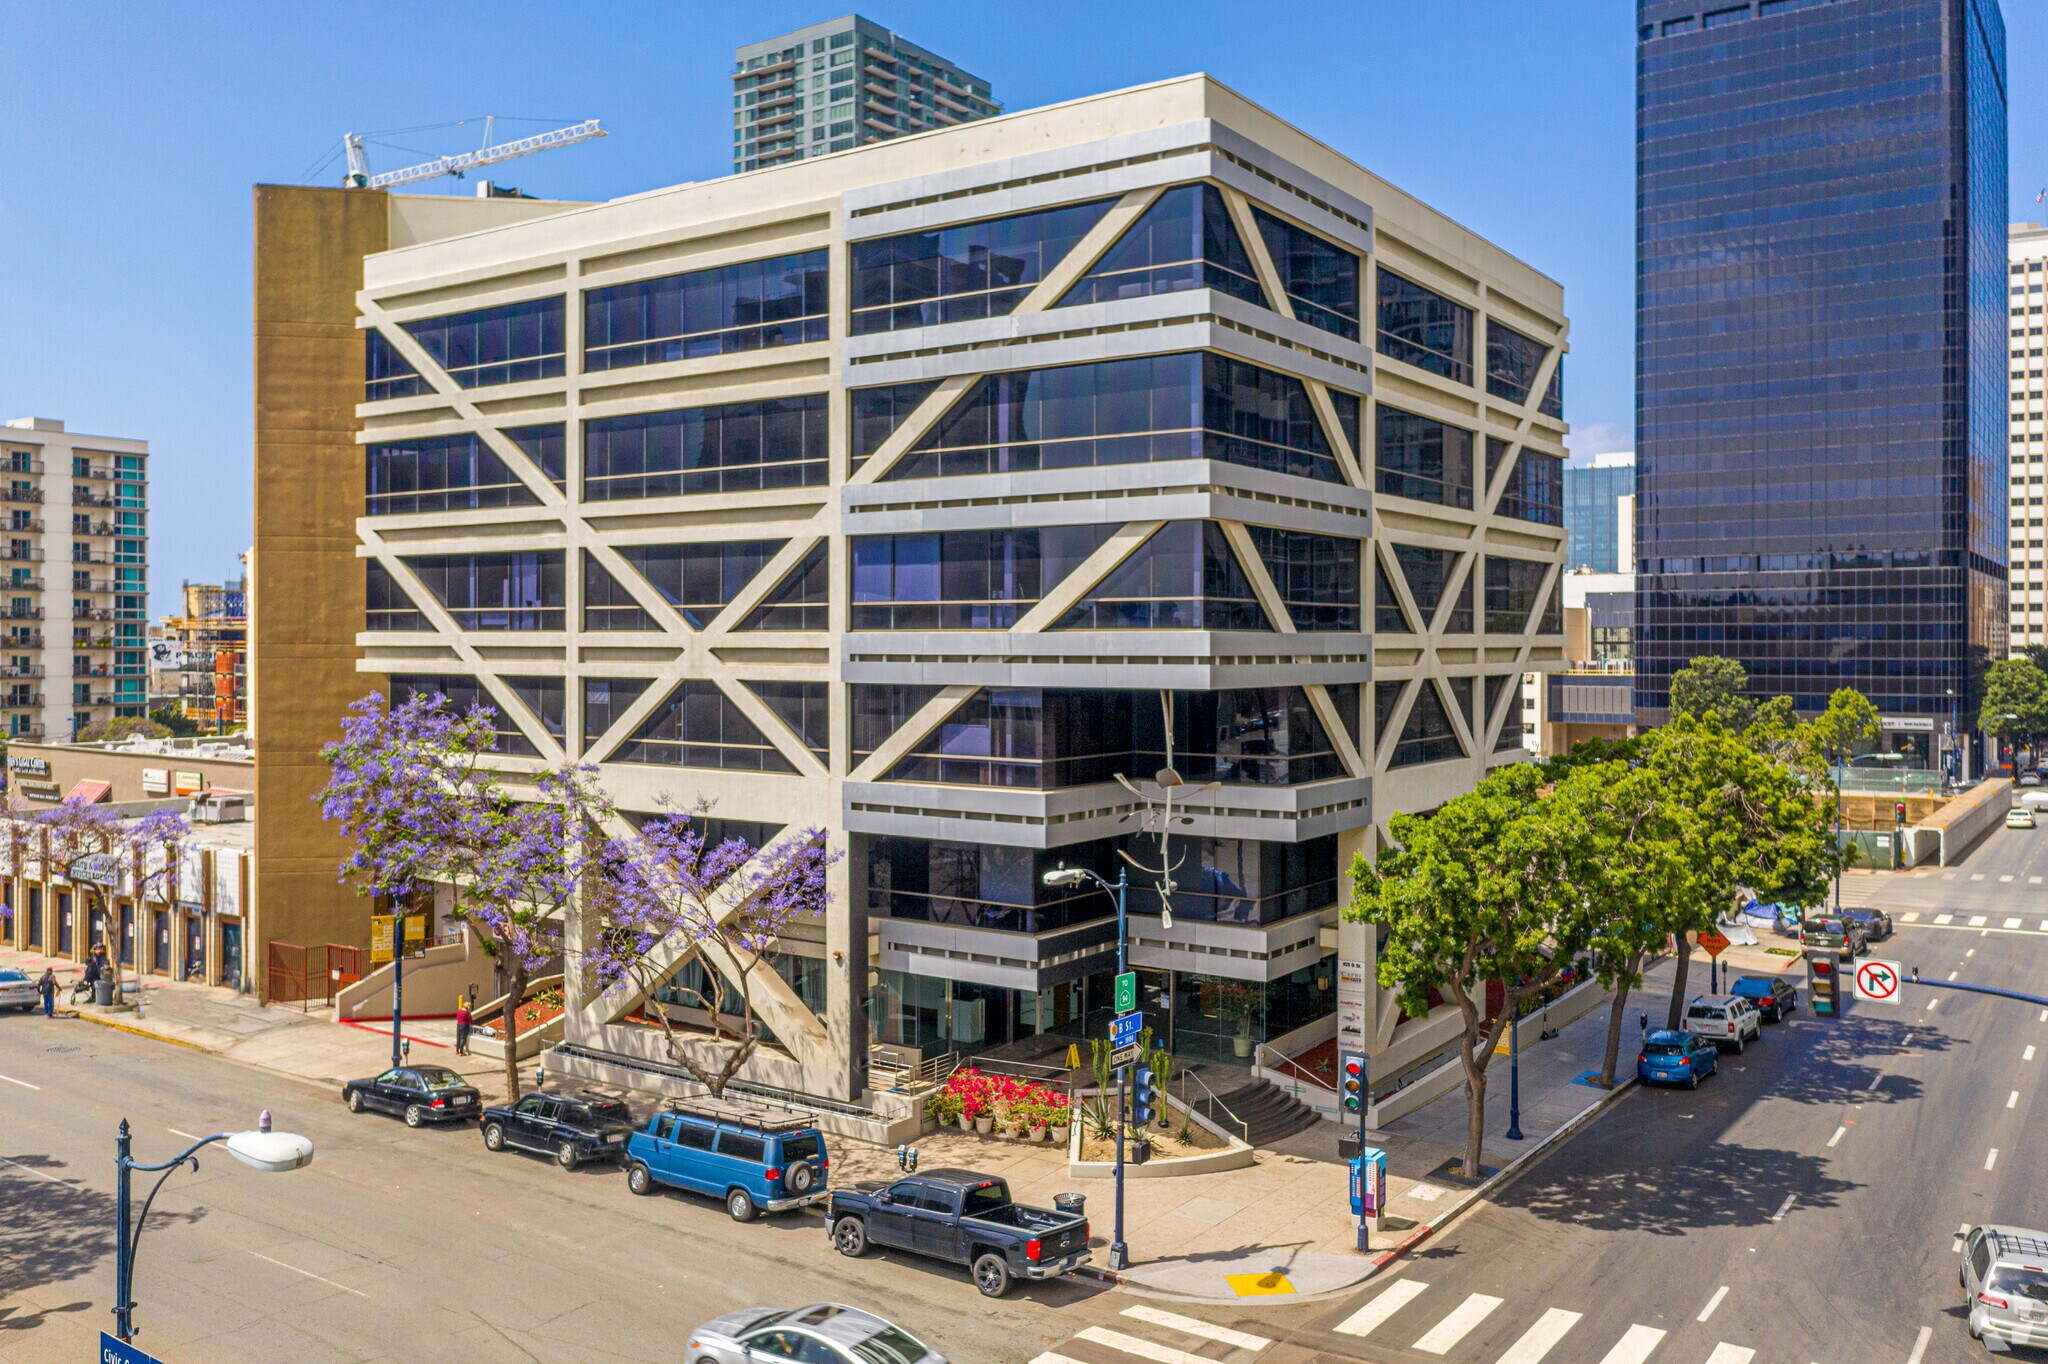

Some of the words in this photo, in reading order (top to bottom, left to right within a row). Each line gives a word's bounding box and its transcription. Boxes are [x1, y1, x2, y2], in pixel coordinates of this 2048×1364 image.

[1122, 979, 1128, 987] TO
[1119, 1022, 1123, 1034] B
[1114, 1053, 1123, 1063] ONE
[1124, 1050, 1134, 1059] WAY
